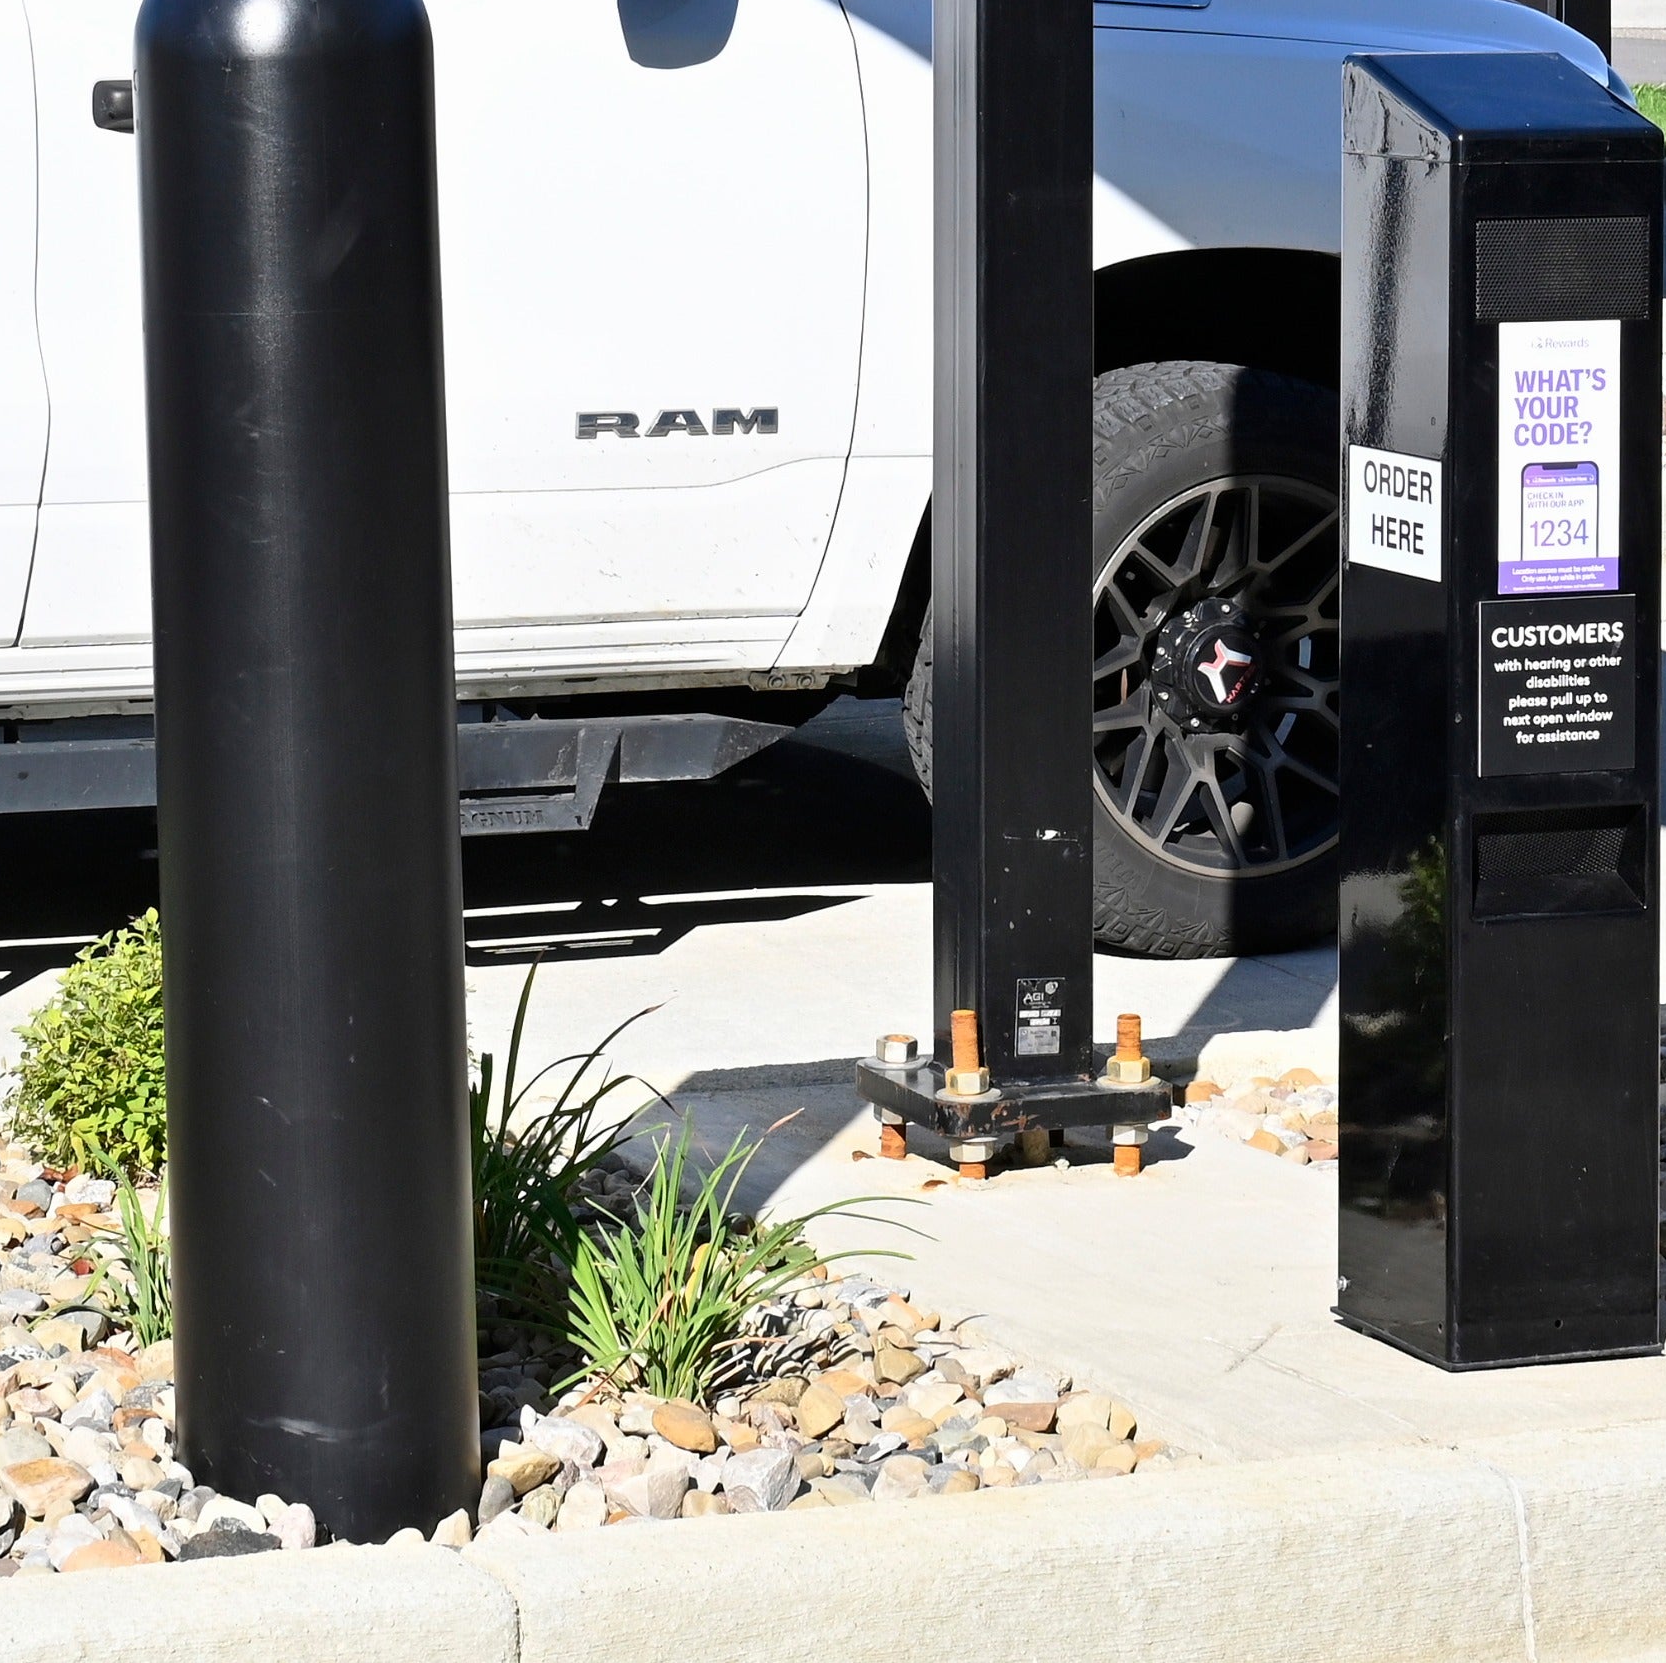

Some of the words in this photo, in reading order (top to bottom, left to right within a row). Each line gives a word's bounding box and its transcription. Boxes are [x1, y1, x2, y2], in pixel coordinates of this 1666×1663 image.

[1545, 338, 1589, 348] Rewards
[1515, 368, 1606, 392] WHAT'S
[1514, 396, 1579, 419] YOUR
[575, 407, 778, 439] RAM
[1514, 421, 1592, 446] CODE?
[1364, 460, 1432, 504] ORDER
[1527, 492, 1555, 500] CHECK
[1551, 500, 1566, 508] OUR
[1372, 513, 1424, 555] HERE
[1530, 519, 1589, 546] 1234
[1491, 622, 1624, 648] CUSTOMERS
[1494, 659, 1522, 672] with
[1524, 657, 1571, 672] hearing
[1573, 659, 1586, 668] or
[1589, 654, 1621, 667] other
[1526, 675, 1590, 688] disabilities
[1509, 695, 1548, 711] please
[1550, 692, 1573, 709] pull
[1576, 694, 1592, 707] up
[1594, 692, 1608, 703] to
[1503, 714, 1531, 726] next
[1533, 714, 1563, 727] open
[1566, 709, 1613, 722] window
[1516, 731, 1534, 744] for
[1536, 730, 1600, 743] assistance
